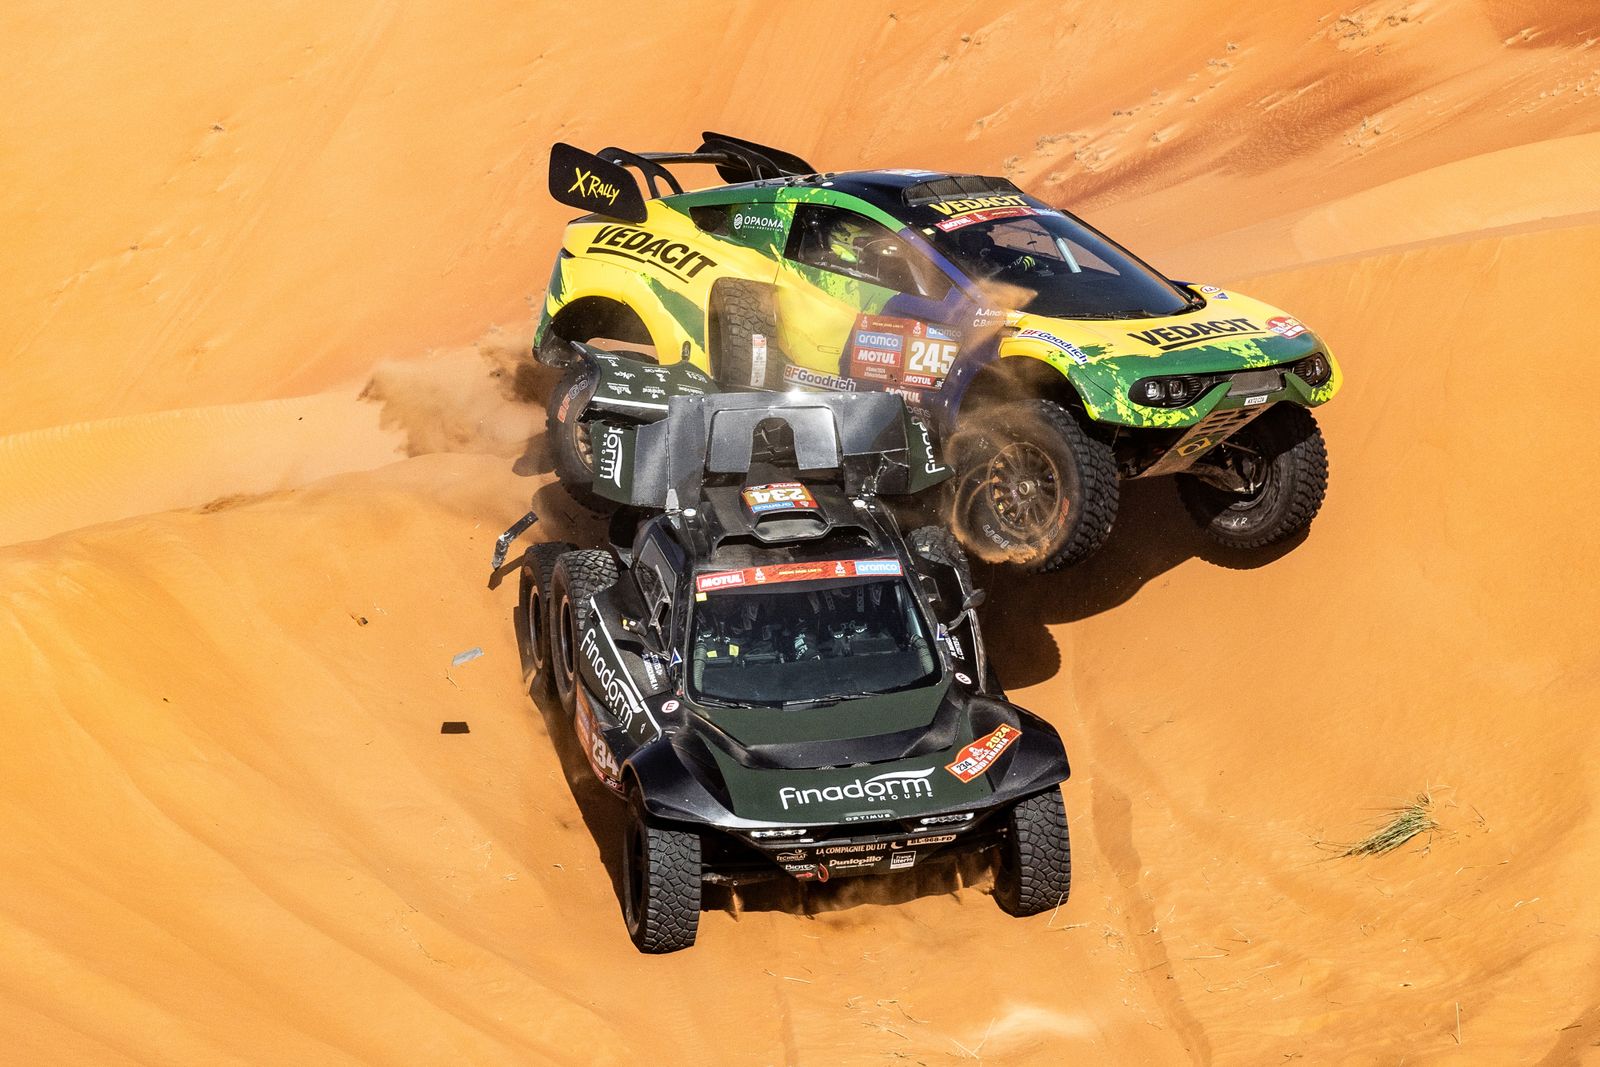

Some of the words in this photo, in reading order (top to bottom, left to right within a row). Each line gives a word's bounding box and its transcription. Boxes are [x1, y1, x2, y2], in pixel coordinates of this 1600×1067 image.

[567, 167, 591, 198] X
[928, 194, 1029, 216] VEDACIT
[743, 215, 784, 229] OPAOMA
[591, 225, 718, 279] VEDACIT
[1126, 317, 1261, 347] VEDACIT
[858, 334, 900, 348] aramco
[1020, 328, 1088, 363] BFGoodrich
[857, 349, 896, 365] MOTUL
[908, 341, 957, 375] 245
[783, 365, 856, 392] BFGoodrich
[904, 375, 932, 386] MOTUL
[749, 488, 806, 504] 234
[856, 564, 899, 573] aramco
[700, 573, 743, 589] MOTUL
[985, 726, 1011, 749] 2024
[591, 732, 620, 777] 234
[956, 760, 973, 773] 234
[867, 790, 934, 803] GROUPE
[844, 812, 892, 822] OPTIMUS
[815, 848, 825, 856] LA
[825, 845, 862, 855] COMPAGNIE
[863, 844, 876, 852] DU
[876, 843, 888, 851] LIT
[828, 855, 883, 867] Dunlopillo
